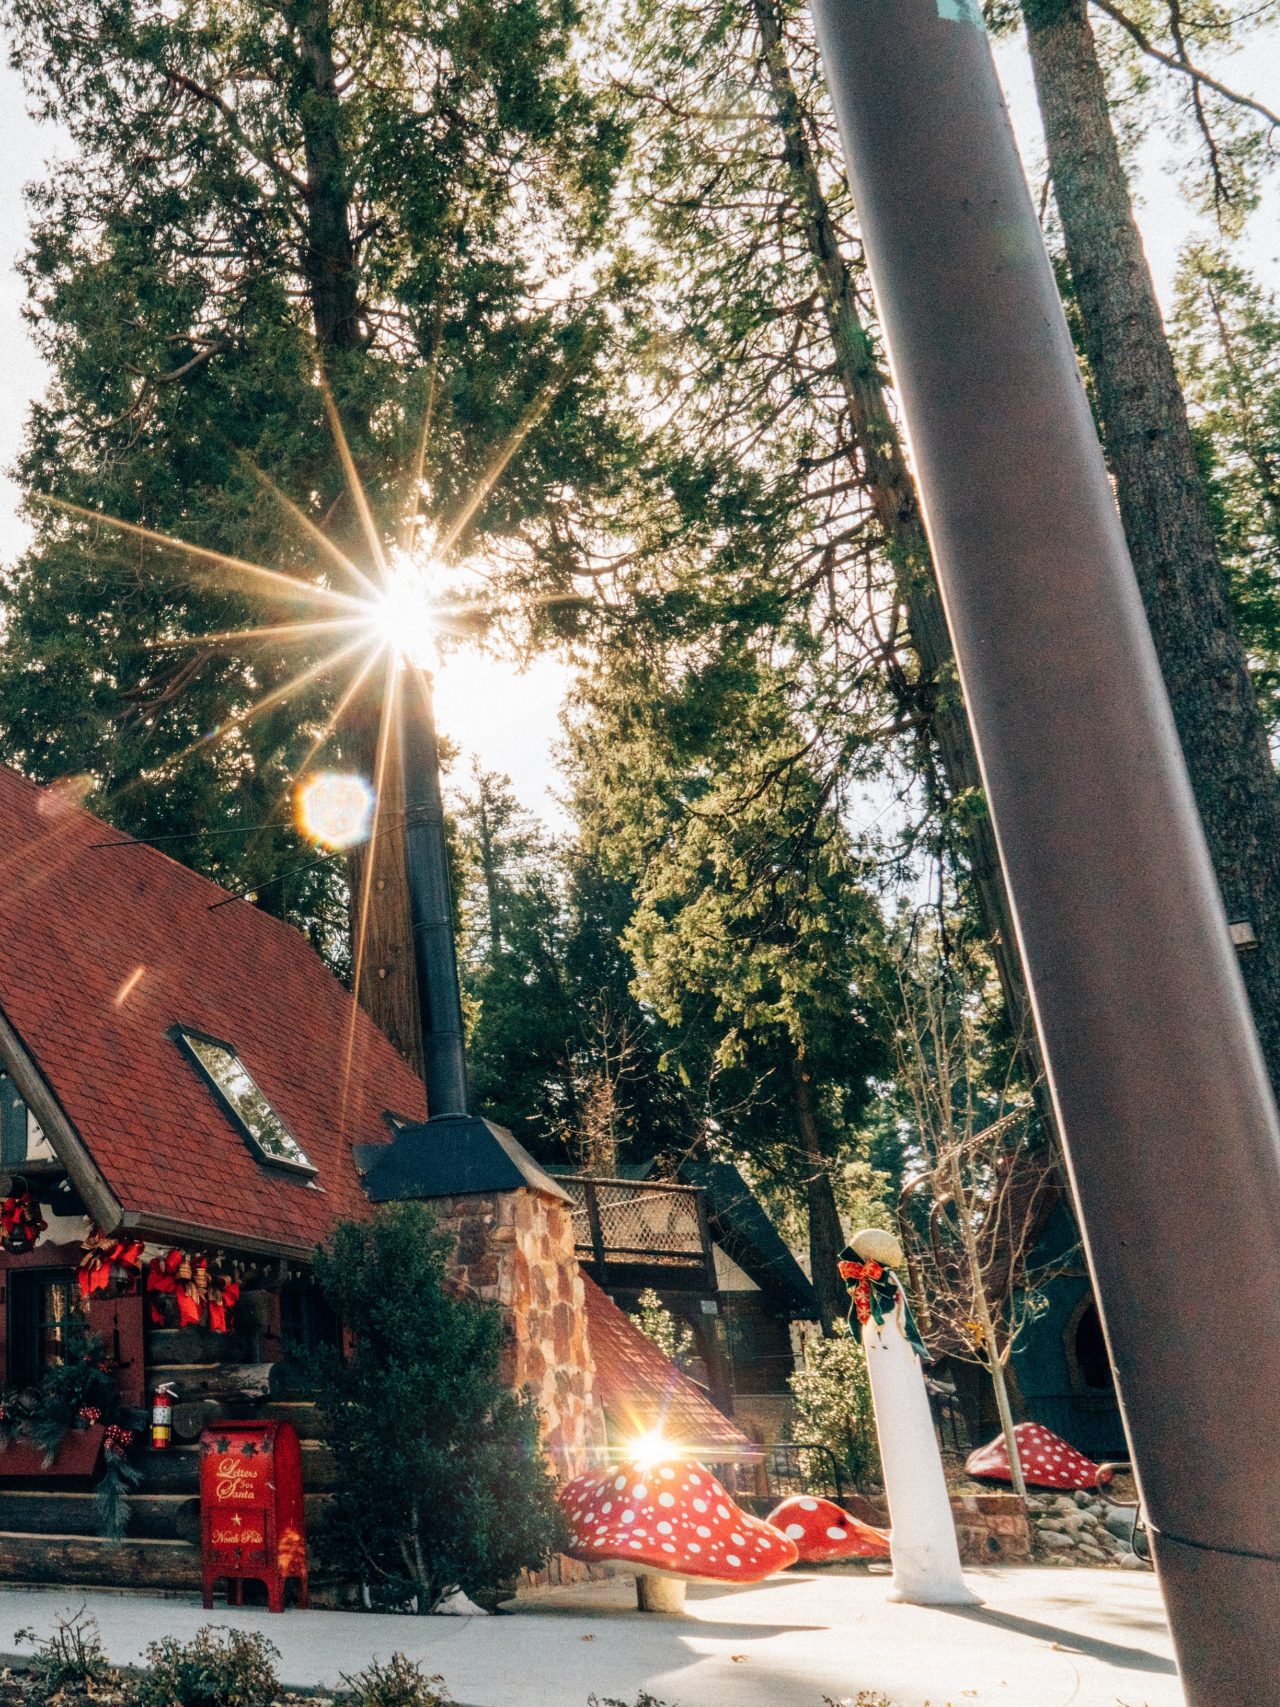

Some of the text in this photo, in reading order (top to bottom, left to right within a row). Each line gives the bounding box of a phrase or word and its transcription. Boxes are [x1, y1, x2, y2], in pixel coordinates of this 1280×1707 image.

[216, 1458, 258, 1479] Letters
[216, 1478, 255, 1502] Santa
[212, 1529, 263, 1544] North Pole
